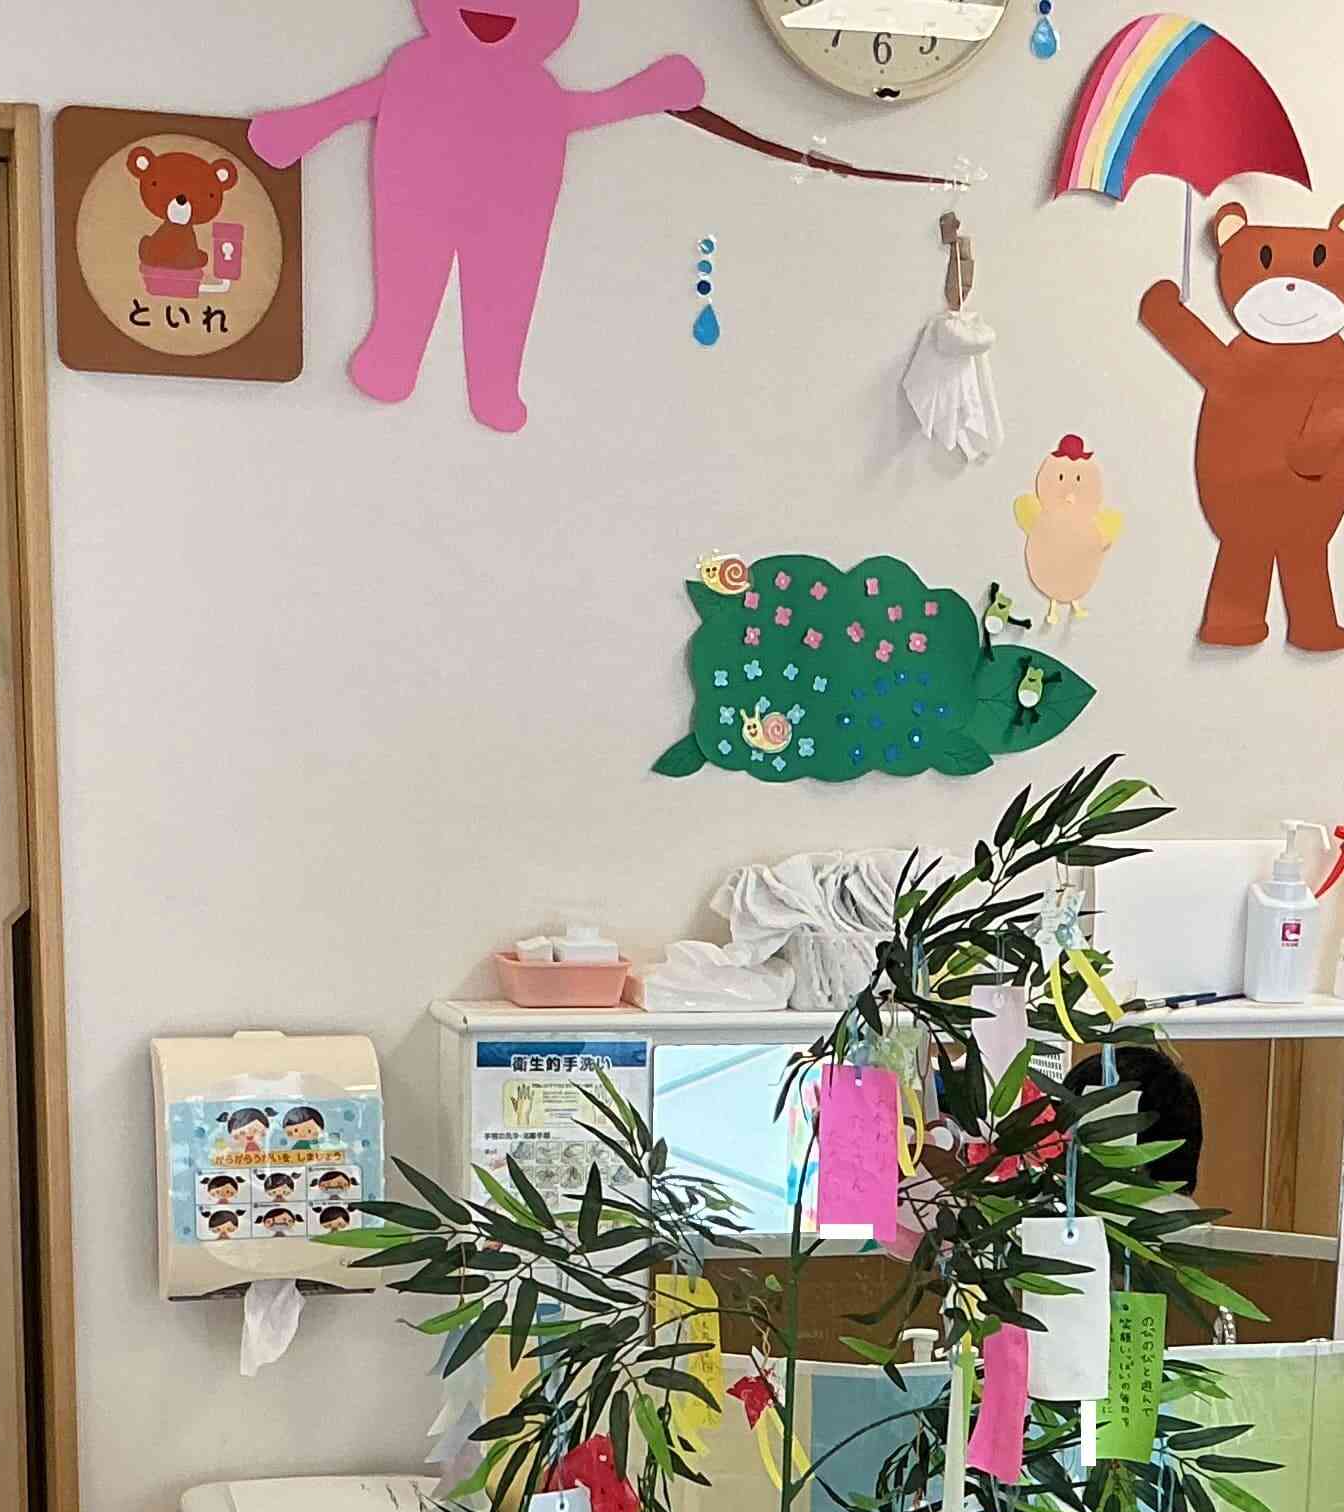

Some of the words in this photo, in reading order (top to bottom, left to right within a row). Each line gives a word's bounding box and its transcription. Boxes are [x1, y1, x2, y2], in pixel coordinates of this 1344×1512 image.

[872, 32, 893, 65] 6
[128, 299, 230, 333] といれ
[512, 1056, 611, 1073] 衛生的手洗い
